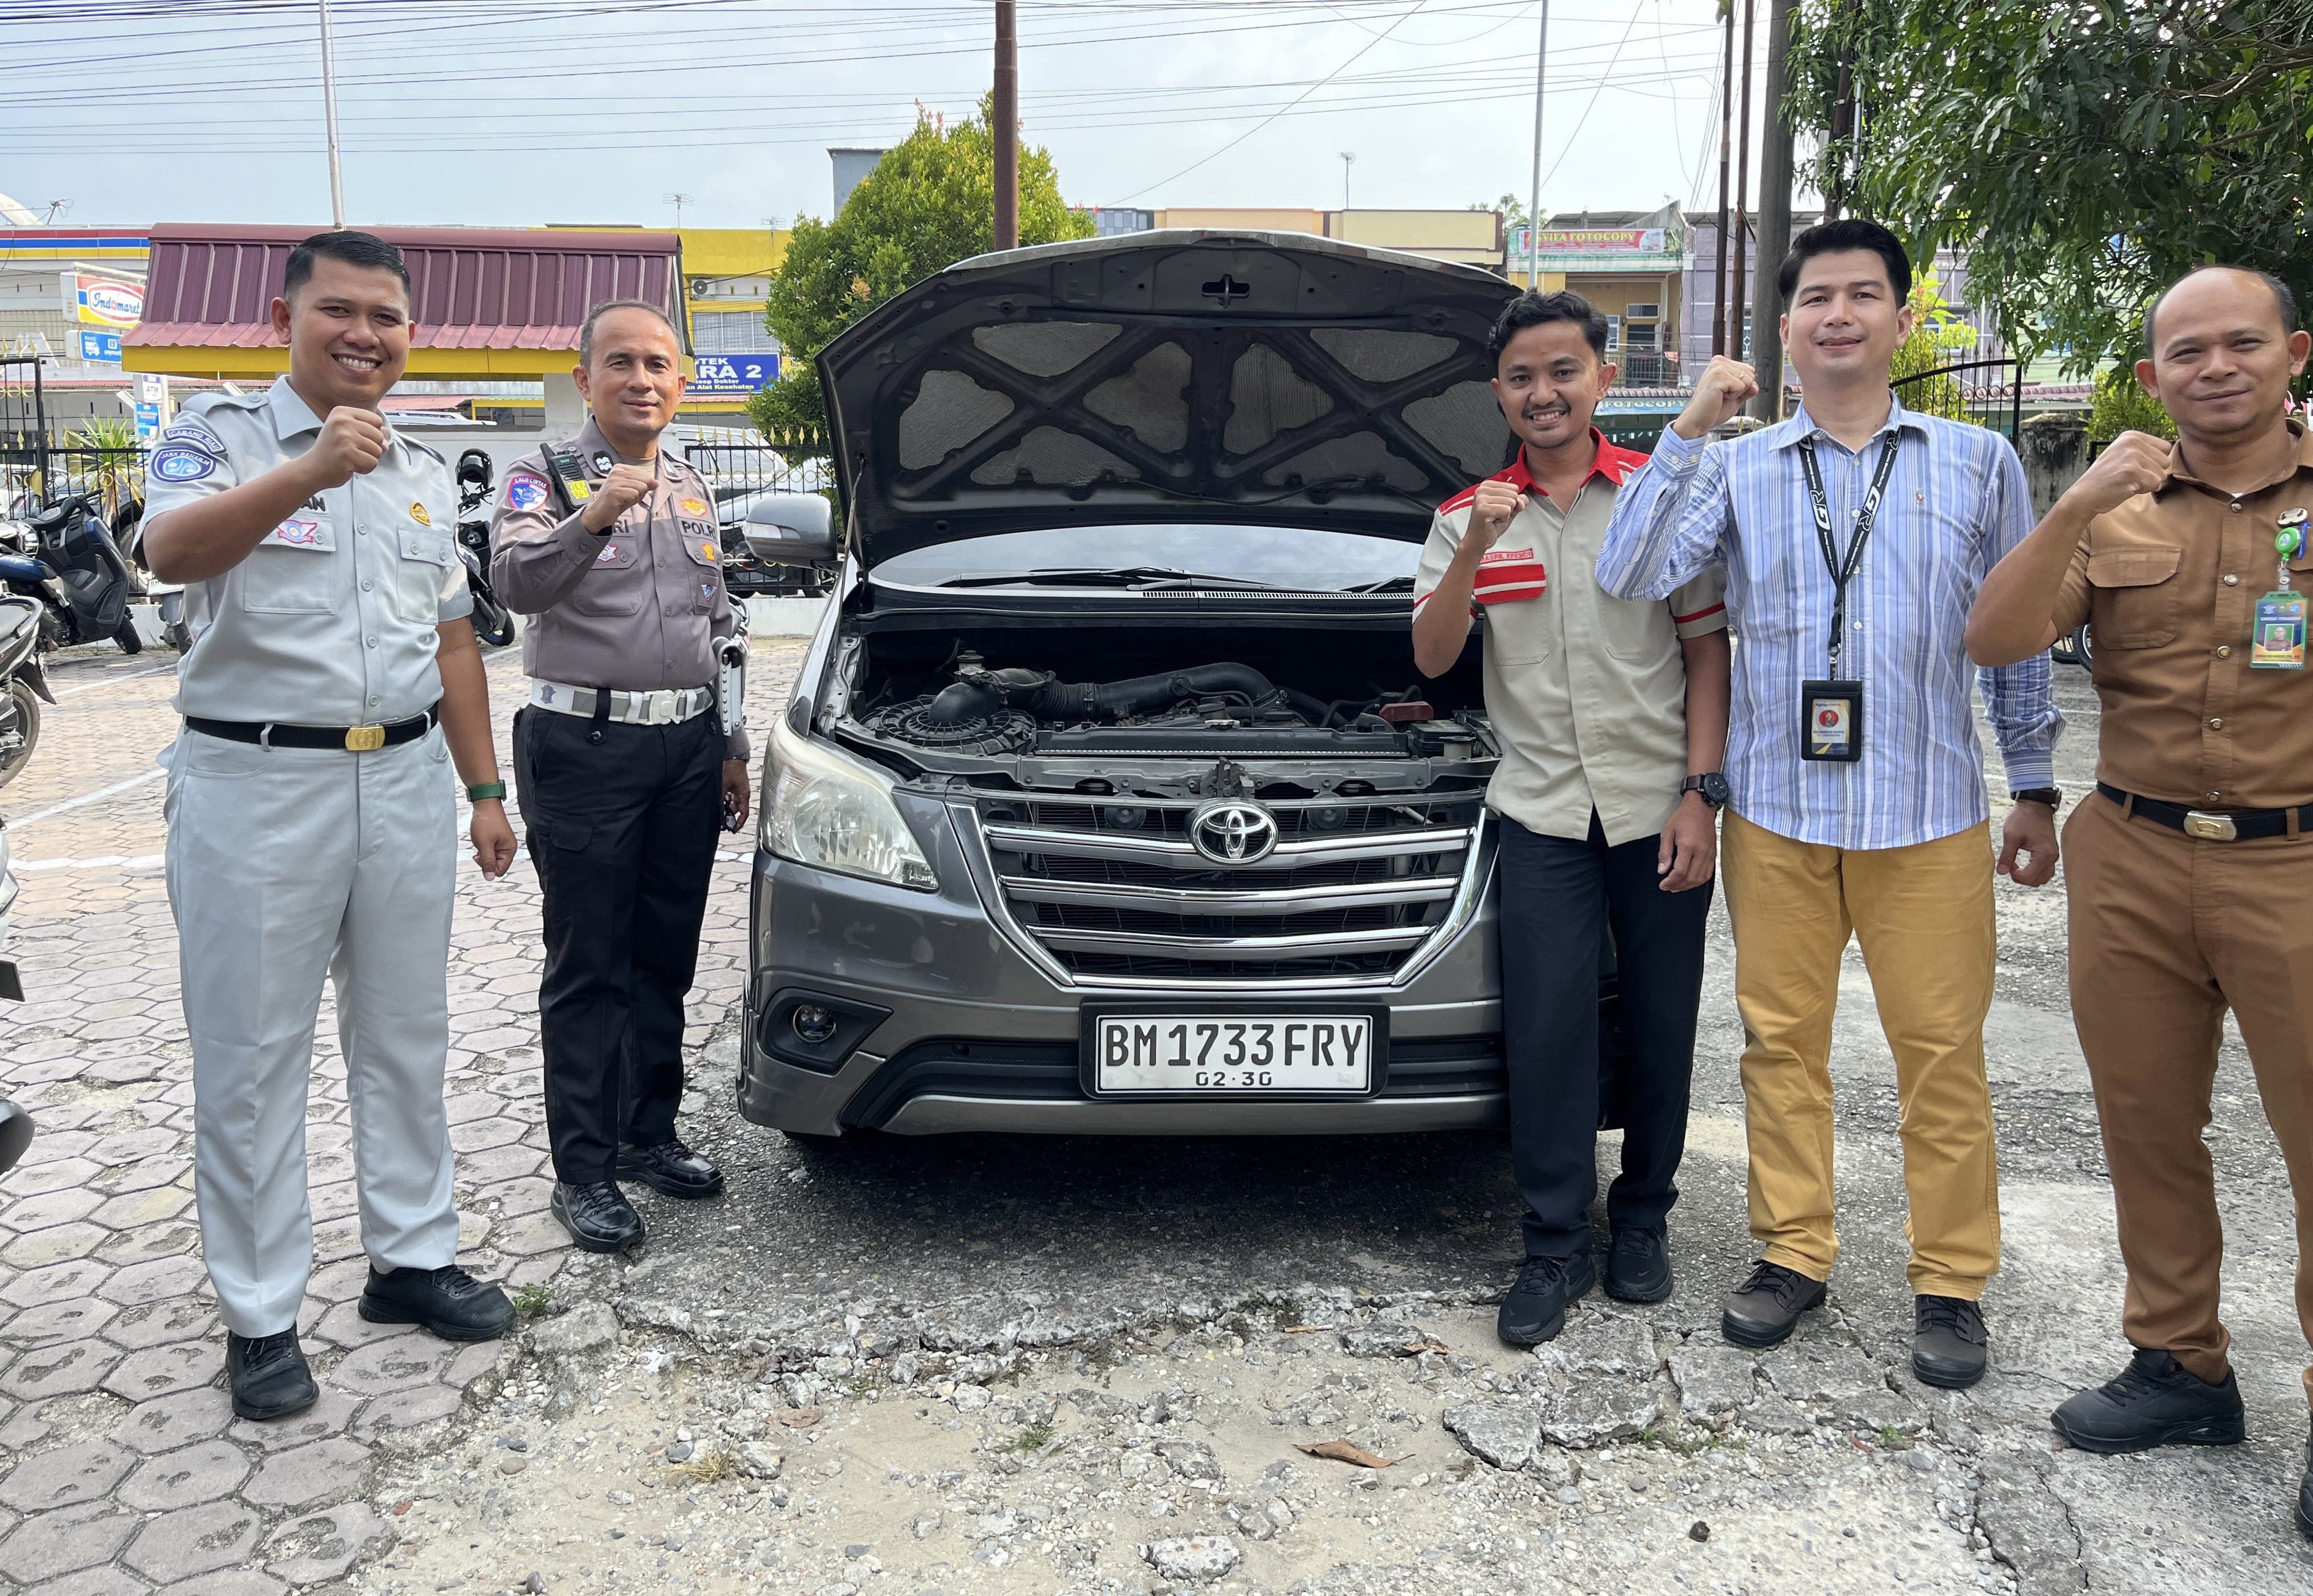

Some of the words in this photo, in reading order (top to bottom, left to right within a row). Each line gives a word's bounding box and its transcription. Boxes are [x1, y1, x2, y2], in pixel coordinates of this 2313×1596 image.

[1570, 231, 1635, 242] FOTOCOPY
[92, 293, 140, 314] Indomaret
[746, 365, 762, 378] 2
[146, 386, 158, 394] ATM
[1605, 400, 1686, 408] FOTOCOPY
[170, 430, 204, 439] CABANG
[204, 437, 220, 450] RIAU
[180, 452, 210, 466] RAHARJA
[681, 520, 717, 540] POLRI
[1506, 551, 1531, 559] EFENDI
[1106, 1024, 1158, 1067] BM
[1167, 1024, 1274, 1067] 1733
[1284, 1024, 1363, 1067] FRY
